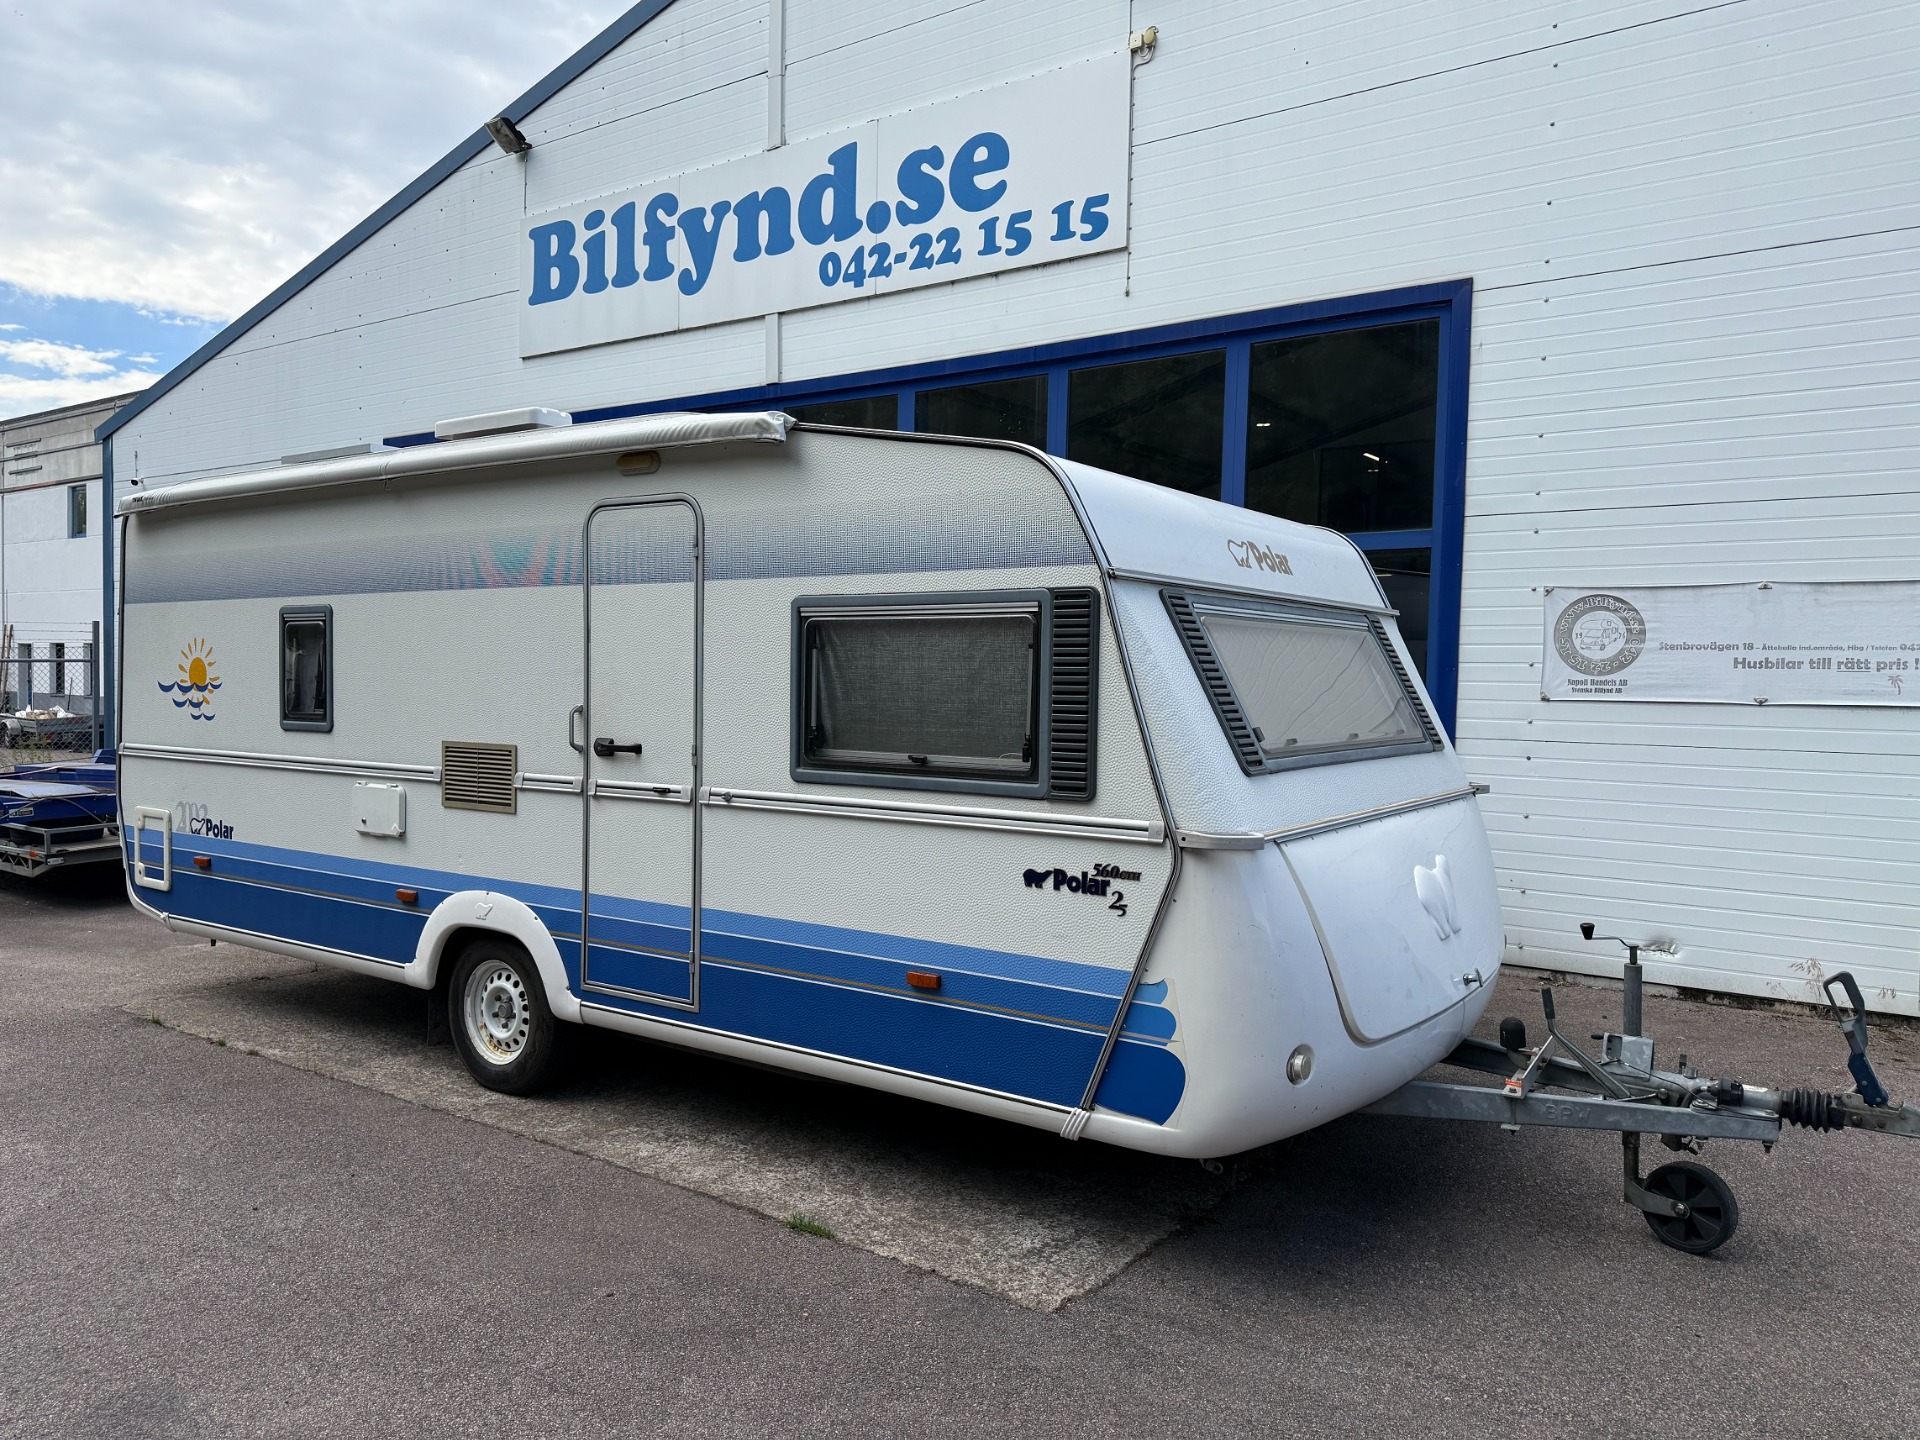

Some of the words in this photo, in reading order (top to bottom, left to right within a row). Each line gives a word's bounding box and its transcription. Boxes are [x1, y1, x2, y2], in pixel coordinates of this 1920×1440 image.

[528, 131, 1010, 306] Bilfynd.se
[819, 226, 962, 288] 042-22
[977, 209, 1033, 256] 15
[1051, 193, 1110, 242] 15
[1246, 540, 1294, 576] Polar
[1659, 641, 1740, 652] Stenbrovägen
[1742, 642, 1754, 651] 18
[1871, 644, 1898, 652] Telefon
[1733, 657, 1805, 670] Husbilar
[1808, 658, 1832, 670] till
[1837, 658, 1871, 670] rätt
[1876, 658, 1909, 672] pris
[1618, 678, 1628, 687] AB
[205, 818, 234, 840] Polar
[1053, 868, 1110, 897] Polar
